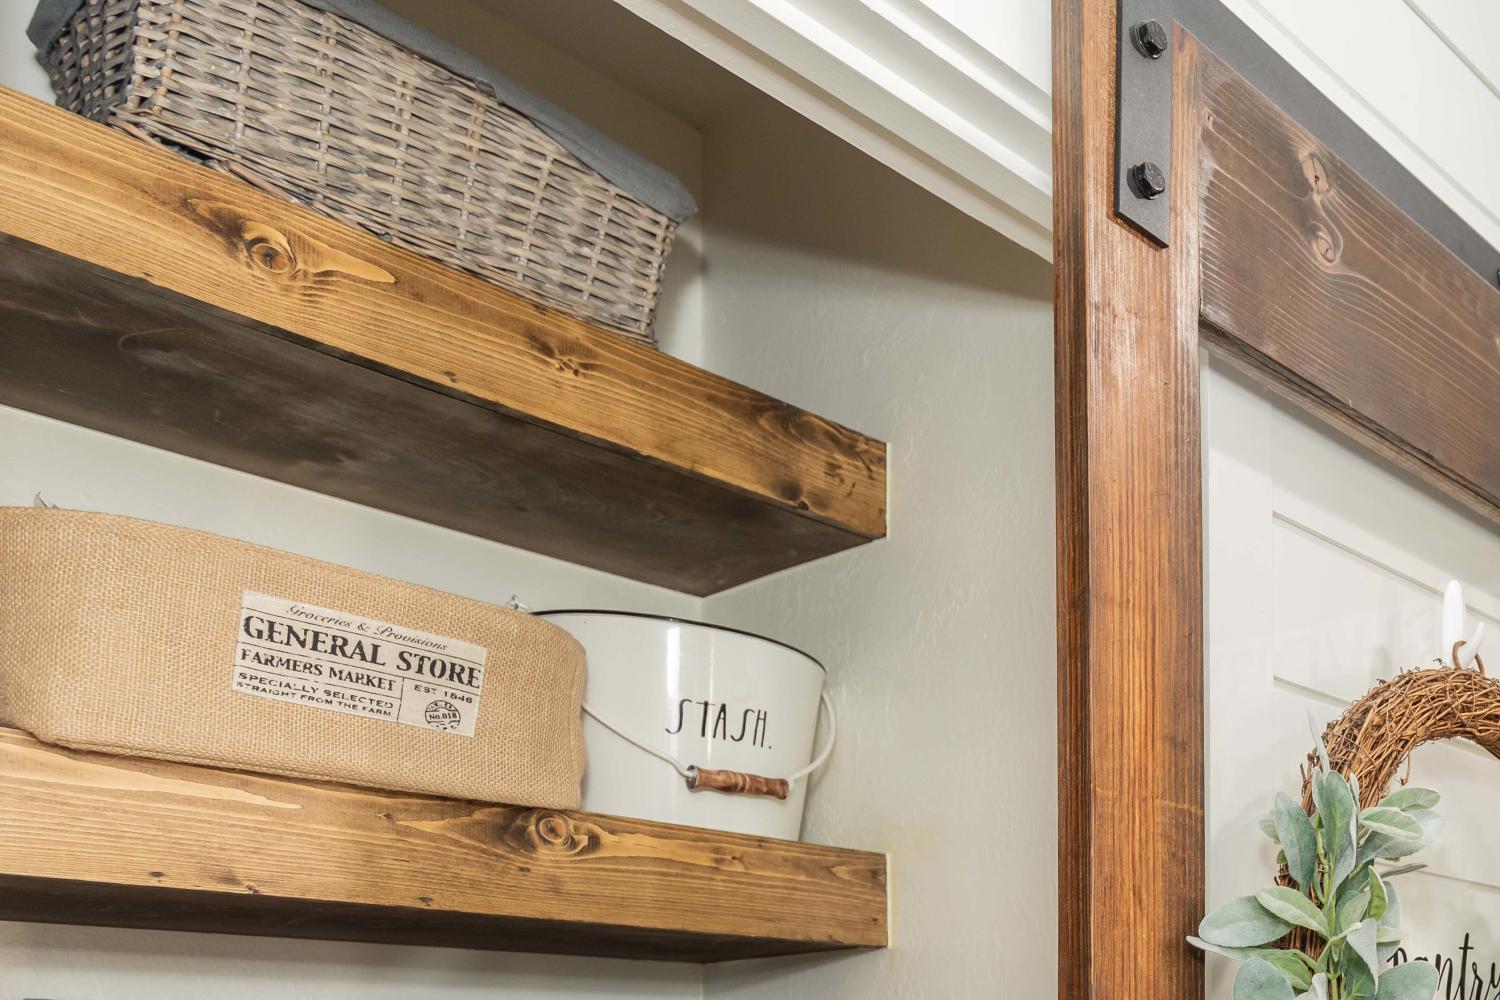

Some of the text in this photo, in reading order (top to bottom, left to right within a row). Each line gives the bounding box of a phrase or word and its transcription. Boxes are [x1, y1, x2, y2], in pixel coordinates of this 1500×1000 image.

[286, 604, 448, 651] Groceries & Provisions
[240, 648, 396, 691] FARMERS MARKET
[243, 615, 481, 689] GENERAL STORE
[236, 682, 392, 717] STRAIGHT FROM THE FARM
[238, 672, 394, 710] SPECIALLY SELECTED
